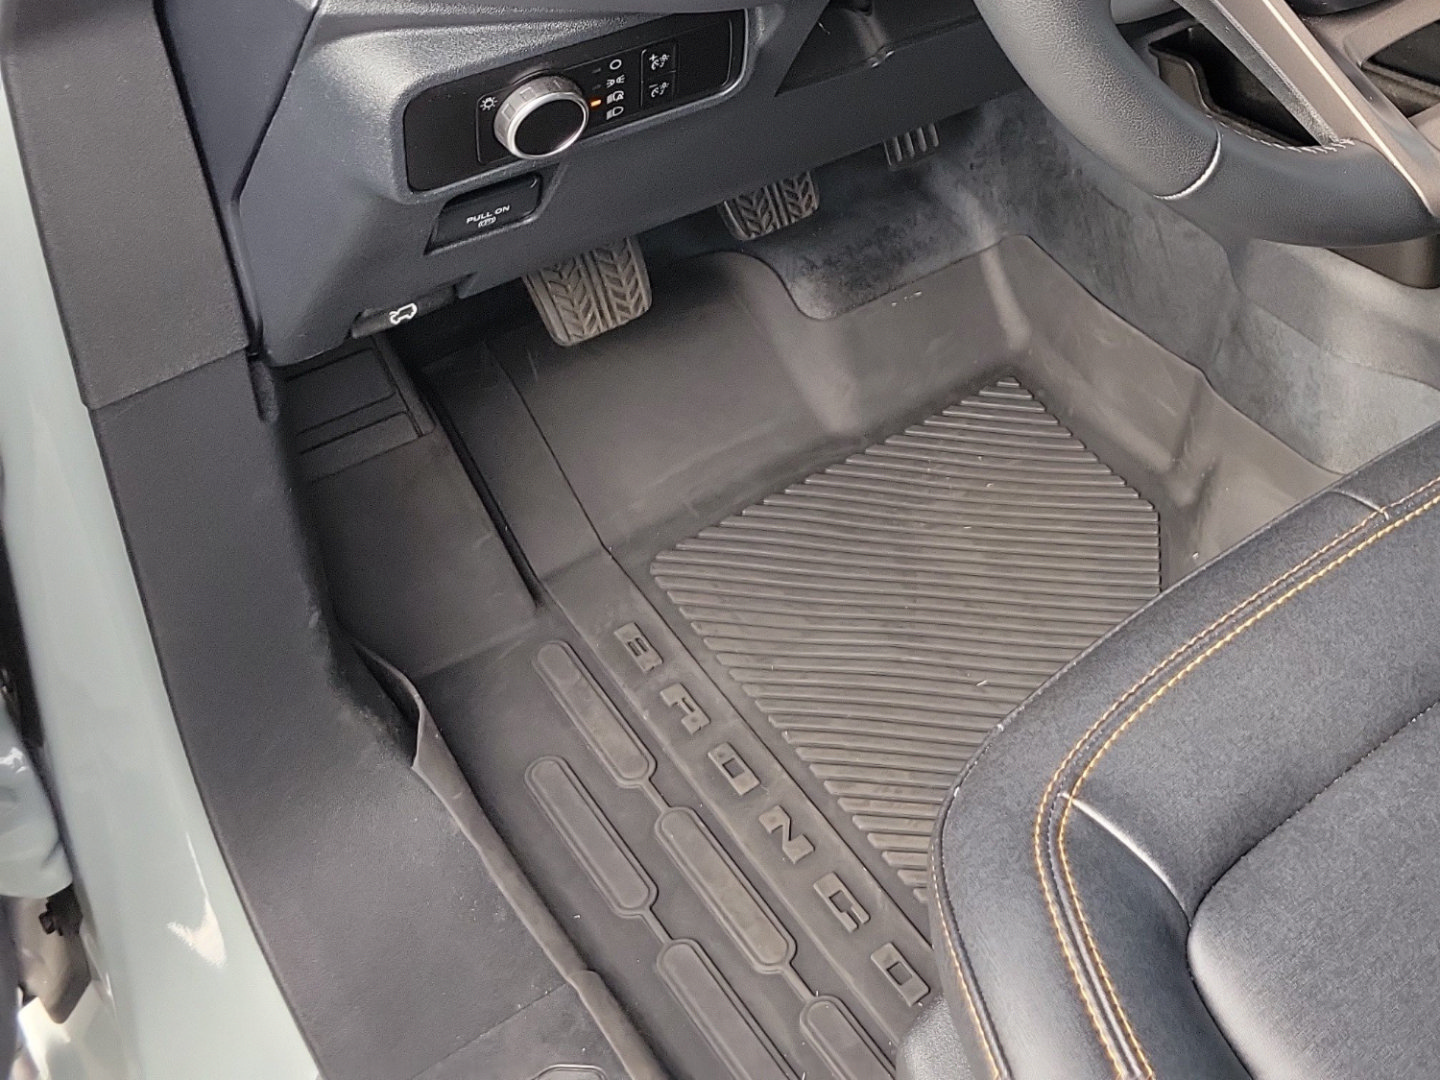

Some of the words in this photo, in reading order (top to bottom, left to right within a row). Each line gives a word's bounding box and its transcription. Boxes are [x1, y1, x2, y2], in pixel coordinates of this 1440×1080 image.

[466, 211, 493, 224] PULL
[494, 204, 511, 215] ON
[613, 621, 932, 1007] BRONCO
